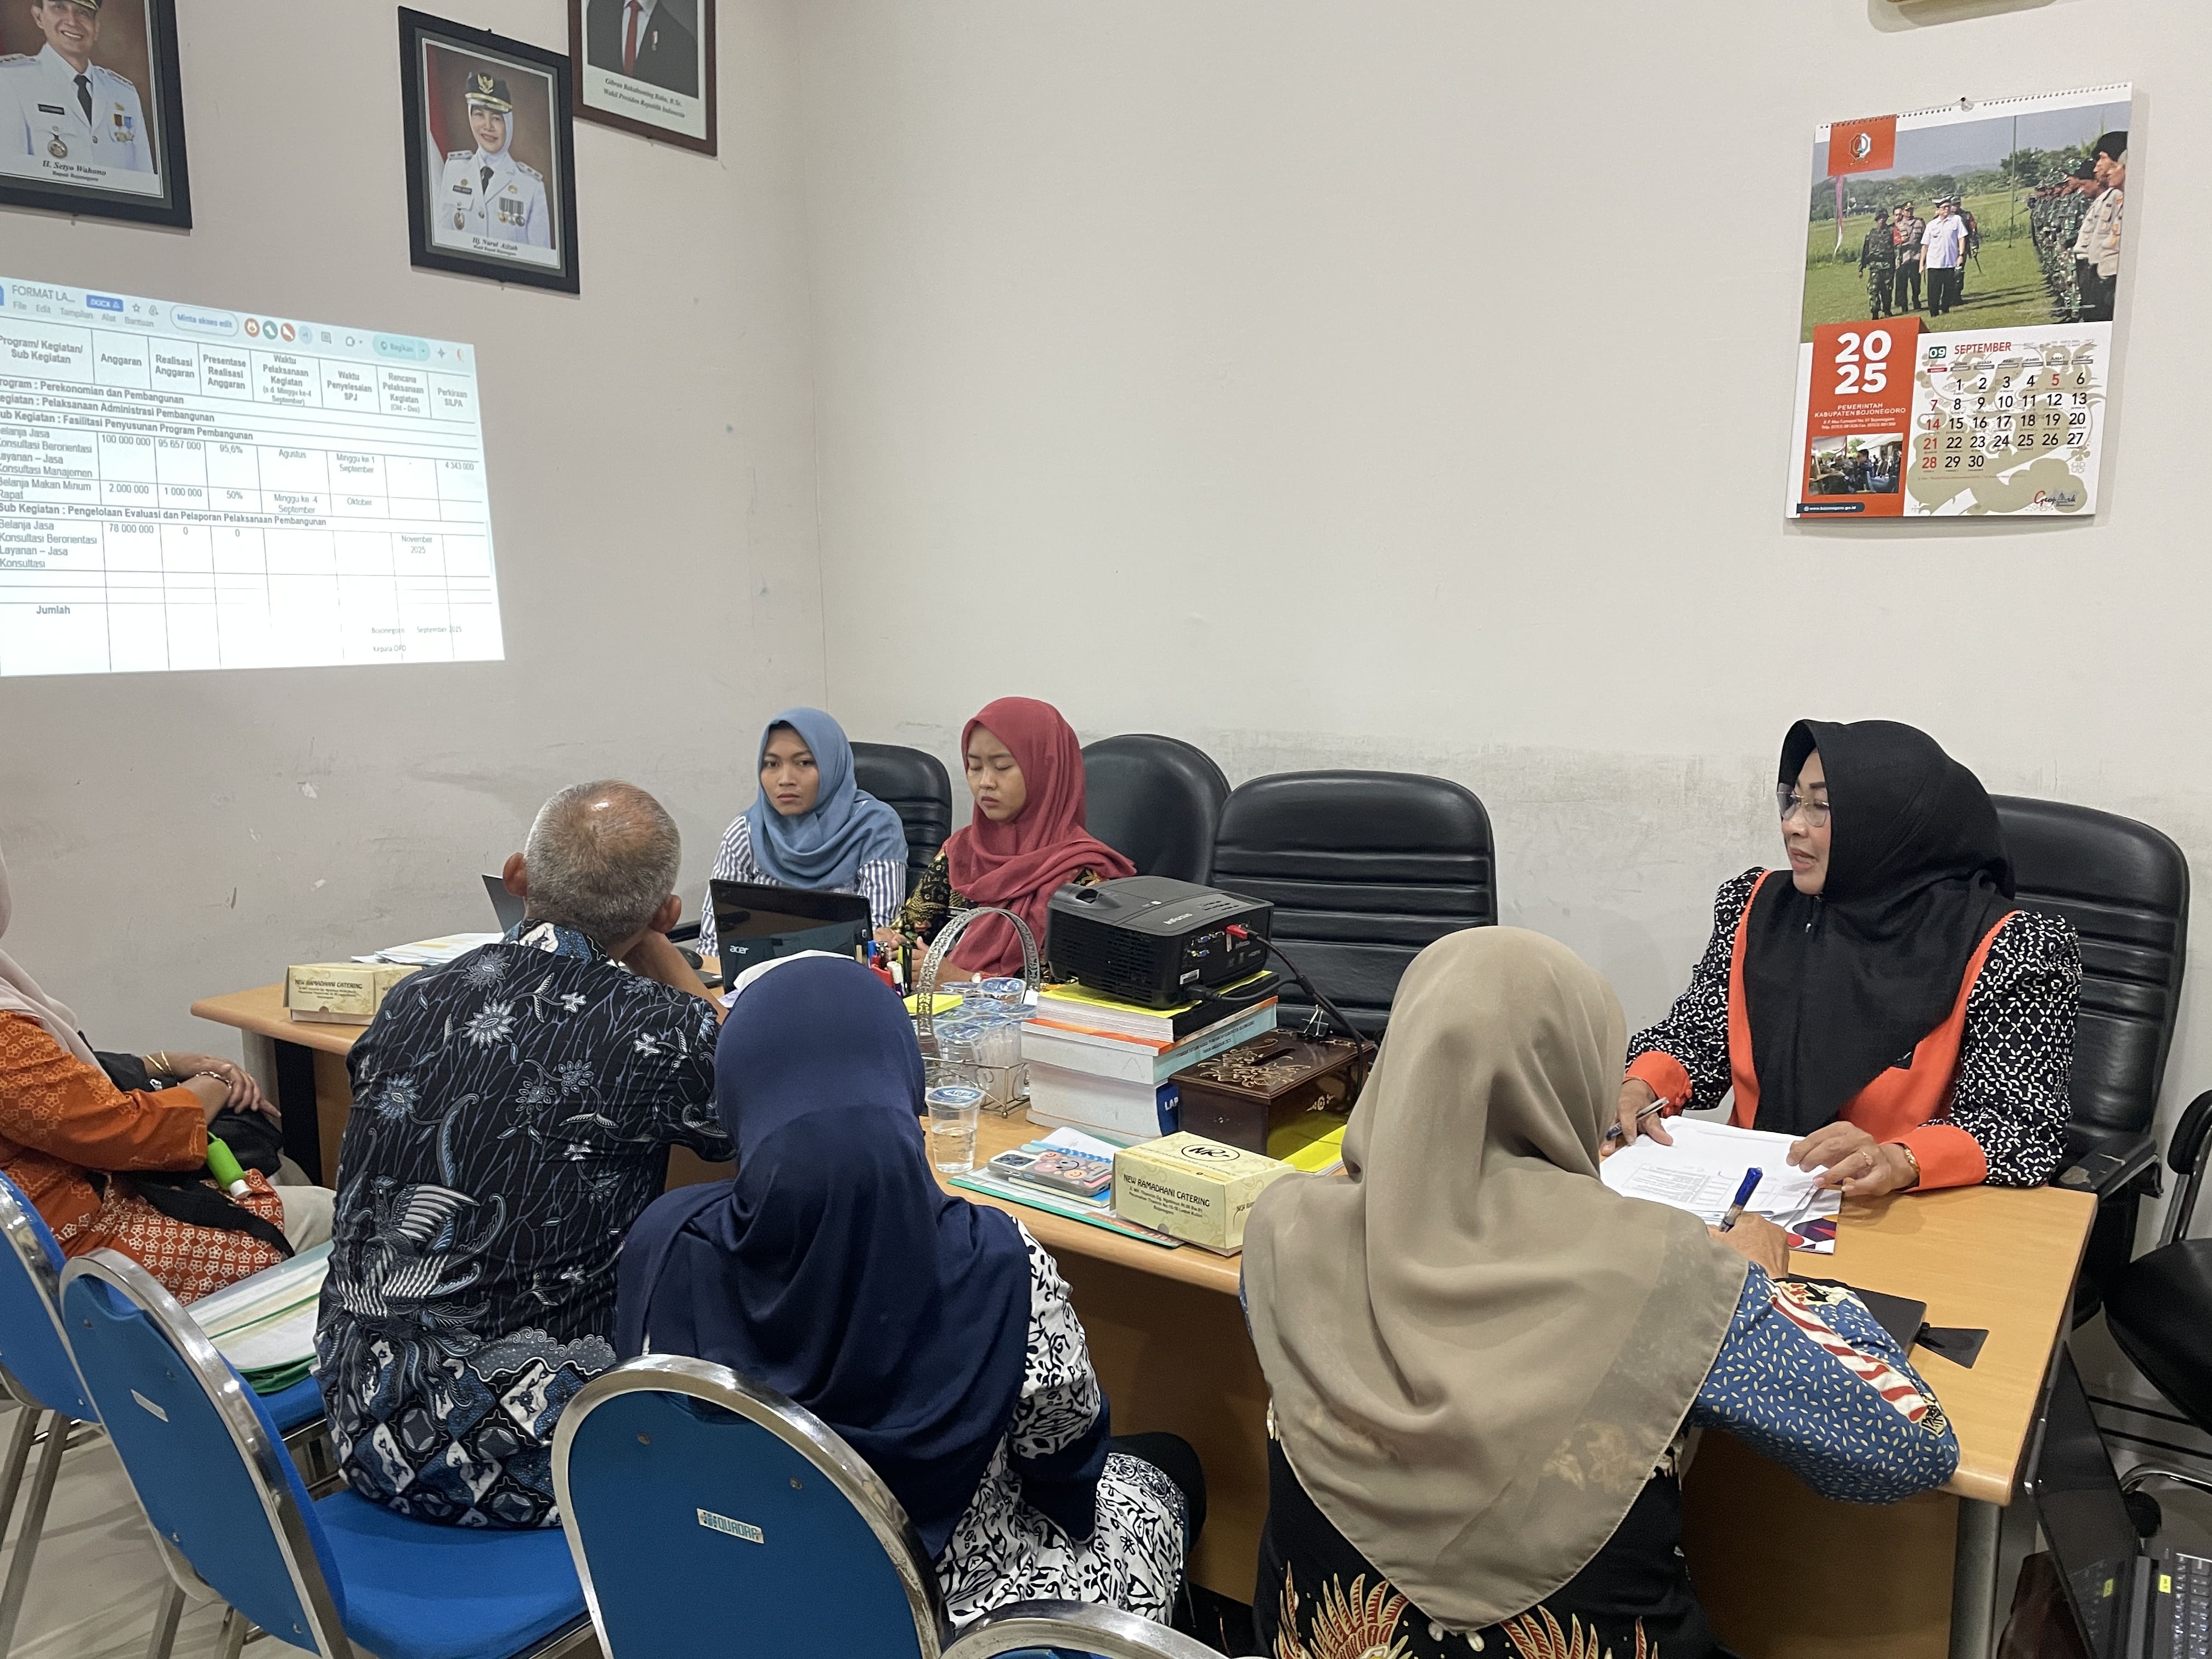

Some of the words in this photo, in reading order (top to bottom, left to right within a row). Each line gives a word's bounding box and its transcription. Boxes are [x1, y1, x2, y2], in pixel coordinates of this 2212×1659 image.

[77, 166, 106, 176] Wahono
[13, 285, 53, 300] FORMAT
[13, 301, 26, 310] File
[36, 304, 51, 313] Edit
[60, 308, 93, 319] Tampilan
[102, 314, 116, 322] Alat
[125, 316, 154, 327] Bantuan
[177, 313, 197, 324] Minta
[198, 317, 217, 326] akses
[219, 319, 233, 328] edit
[1835, 330, 1892, 363] 20
[1929, 348, 1946, 357] 09
[1955, 342, 2012, 354] SEPTEMBER
[12, 349, 29, 359] Sub
[31, 351, 71, 363] Kegiatan
[100, 353, 142, 366] Anggaran
[155, 354, 193, 367] Realisasi
[203, 354, 246, 368] Presentase
[274, 355, 296, 364] Waktu
[155, 365, 195, 378] Anggaran
[208, 366, 244, 379] Realisasi
[263, 364, 308, 376] Pelaksanaan
[338, 370, 359, 380] Waktu
[207, 376, 246, 390] Anggaran
[271, 375, 302, 387] Kegiatan
[388, 373, 416, 384] Rencana
[1835, 362, 1887, 395] 25
[1955, 379, 1962, 391] 1
[1978, 377, 1987, 390] 2
[2002, 376, 2010, 388] 3
[2027, 375, 2035, 387] 4
[2052, 374, 2059, 386] 5
[2076, 373, 2085, 385] 6
[0, 379, 32, 389] rogram
[41, 381, 104, 396] Perekonomian
[106, 389, 122, 398] dan
[124, 390, 184, 405] Pembangunan
[327, 380, 373, 392] Penyelesaian
[382, 382, 424, 394] Pelaksanaan
[390, 393, 419, 404] Kegiatan
[437, 387, 467, 398] Perkiraan
[1931, 399, 1938, 411] 7
[1954, 398, 1961, 410] 8
[1977, 397, 1985, 409] 9
[1998, 396, 2013, 408] 10
[2023, 395, 2036, 407] 11
[2047, 394, 2062, 405] 12
[2072, 393, 2086, 404] 13
[0, 394, 34, 405] egiatan
[42, 397, 98, 411] Pelaksanaan
[100, 403, 154, 416] Administrasi
[156, 408, 215, 423] Pembangunan
[1856, 408, 1906, 416] BOJONEGORO
[0, 410, 12, 419] ub
[15, 411, 55, 422] Kegiatan
[63, 416, 103, 428] Fasilitasi
[105, 419, 157, 434] Penyusunan
[160, 423, 194, 435] Program
[196, 426, 253, 441] Pembangunan
[1927, 419, 1940, 431] 14
[1949, 418, 1963, 430] 15
[1973, 417, 1987, 428] 16
[1996, 416, 2011, 427] 17
[2021, 415, 2035, 426] 18
[2045, 414, 2061, 425] 19
[2069, 413, 2085, 425] 20
[0, 427, 27, 438] elanja
[29, 428, 50, 438] Jasa
[42, 441, 92, 453] Berorientasi
[1923, 438, 1938, 450] 21
[1946, 437, 1962, 449] 22
[1970, 436, 1985, 448] 23
[1994, 436, 2009, 447] 24
[2018, 435, 2034, 446] 25
[2042, 434, 2058, 445] 26
[2067, 433, 2084, 445] 27
[43, 454, 64, 464] Jasa
[279, 449, 306, 459] Agustus
[336, 453, 360, 463] Minggu
[1922, 457, 1937, 469] 28
[1945, 456, 1961, 468] 29
[1968, 456, 1984, 467] 30
[43, 466, 92, 478] Manajemen
[339, 465, 374, 473] September
[32, 479, 60, 489] Makan
[63, 481, 91, 490] Minum
[227, 490, 243, 499] 50%
[274, 494, 298, 504] Minggu
[347, 498, 373, 506] Oktober
[0, 504, 16, 512] Sub
[19, 504, 60, 515] Kegiatan
[68, 506, 122, 517] Pengelolaan
[125, 509, 161, 518] Evaluasi
[163, 511, 178, 519] dan
[181, 511, 222, 522] Pelaporan
[223, 514, 272, 524] Pelaksanaan
[274, 516, 326, 526] Pembangunan
[279, 505, 315, 515] September
[33, 521, 54, 530] Jasa
[183, 527, 188, 535] 0
[0, 533, 44, 543] Konsultasi
[47, 534, 97, 544] Berorientasi
[235, 529, 240, 537] 0
[402, 535, 433, 543] November
[0, 545, 37, 556] Layanan
[48, 546, 68, 556] Jasa
[411, 546, 426, 554] 2025
[0, 558, 46, 568] Konsultasi
[36, 605, 70, 614] Jumlah
[730, 945, 748, 954] acer
[1124, 1174, 1137, 1184] NEW
[1137, 1179, 1175, 1197] RAMADHANI
[1177, 1191, 1210, 1207] CATERING
